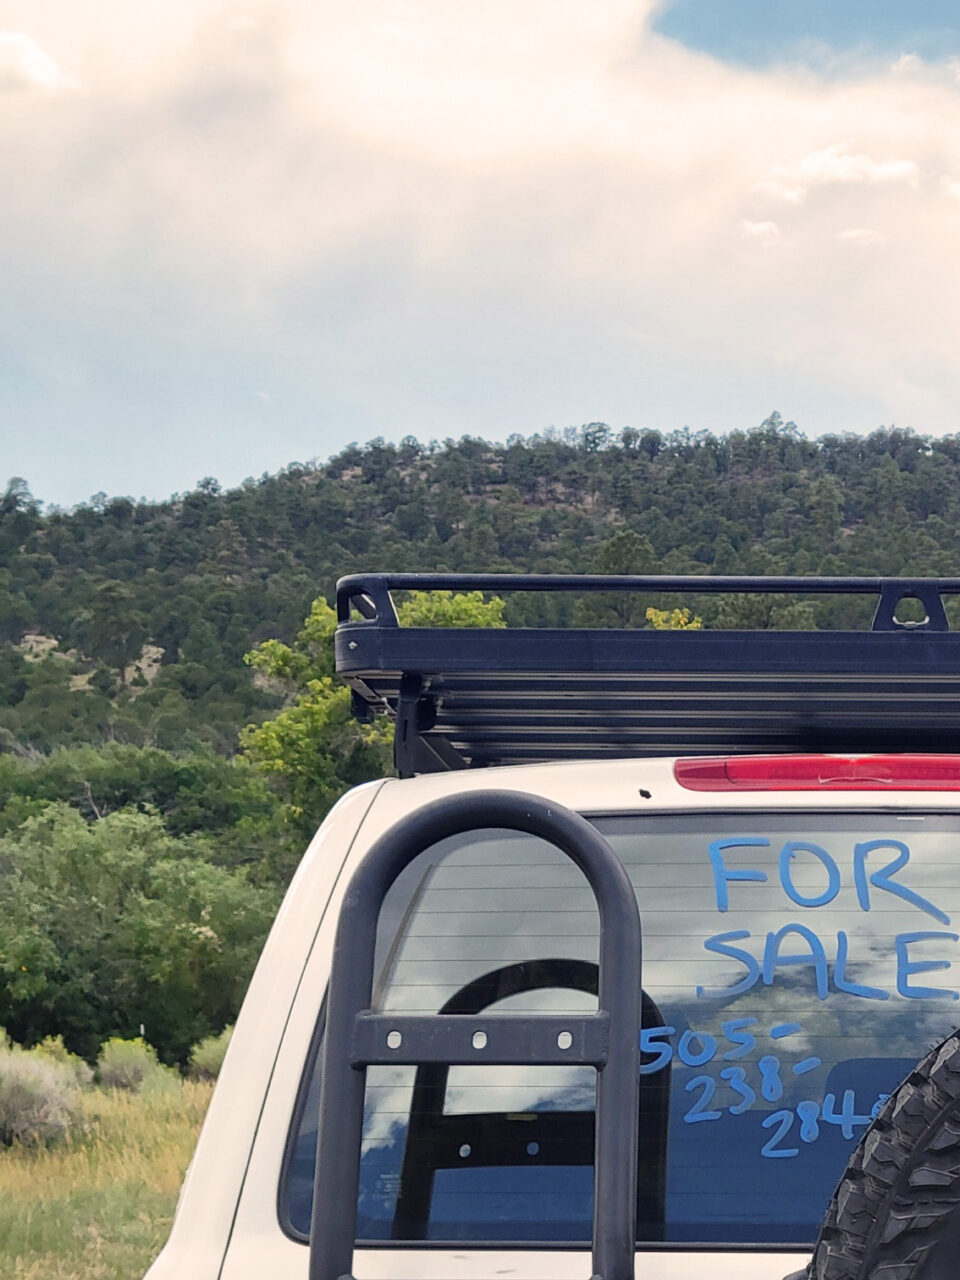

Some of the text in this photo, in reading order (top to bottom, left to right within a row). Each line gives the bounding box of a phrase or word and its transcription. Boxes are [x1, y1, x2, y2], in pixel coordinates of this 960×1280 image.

[708, 837, 950, 926] FOR
[696, 922, 960, 1000] SALE
[639, 1017, 800, 1074] 505-
[684, 1055, 822, 1124] 238-
[760, 1089, 893, 1158] 284
